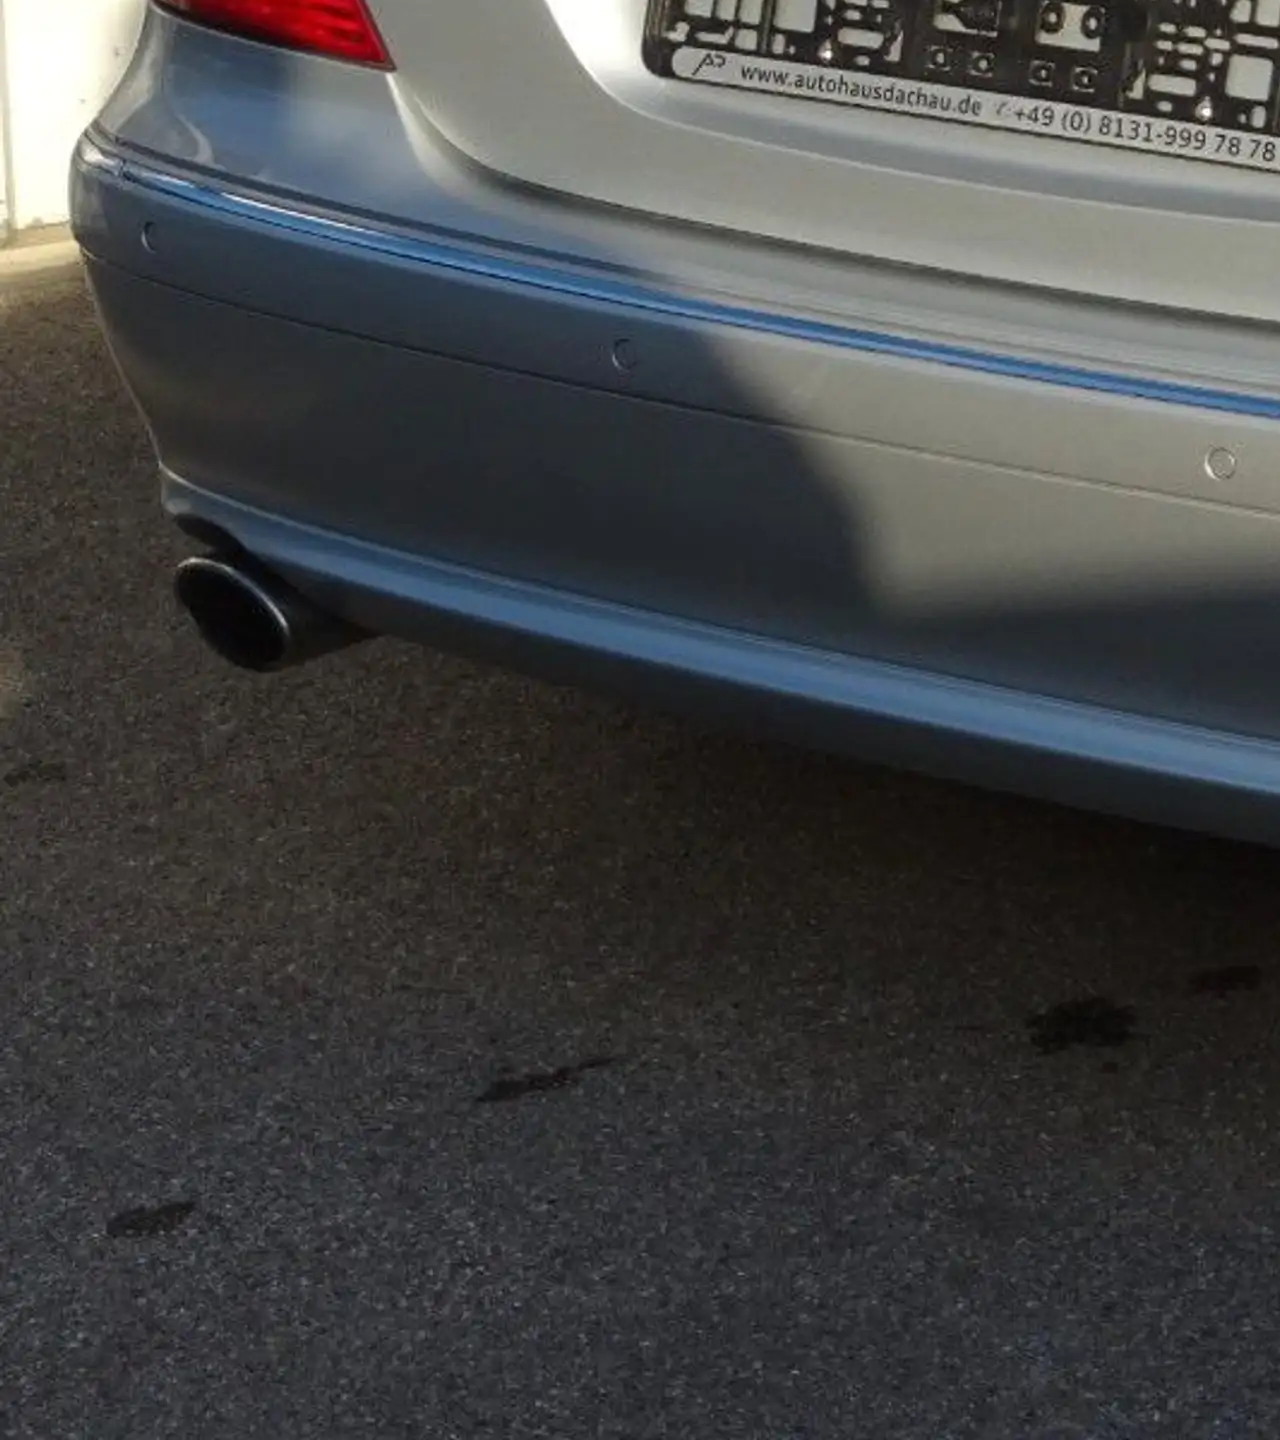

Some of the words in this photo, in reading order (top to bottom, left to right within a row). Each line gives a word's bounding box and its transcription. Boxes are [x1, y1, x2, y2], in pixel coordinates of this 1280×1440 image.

[740, 63, 983, 117] www.autohausdachau.de
[1014, 106, 1055, 128] +49
[1061, 111, 1092, 134] (0)
[1098, 115, 1207, 150] 8131-999
[1215, 133, 1241, 157] 78
[1249, 138, 1276, 161] 78
